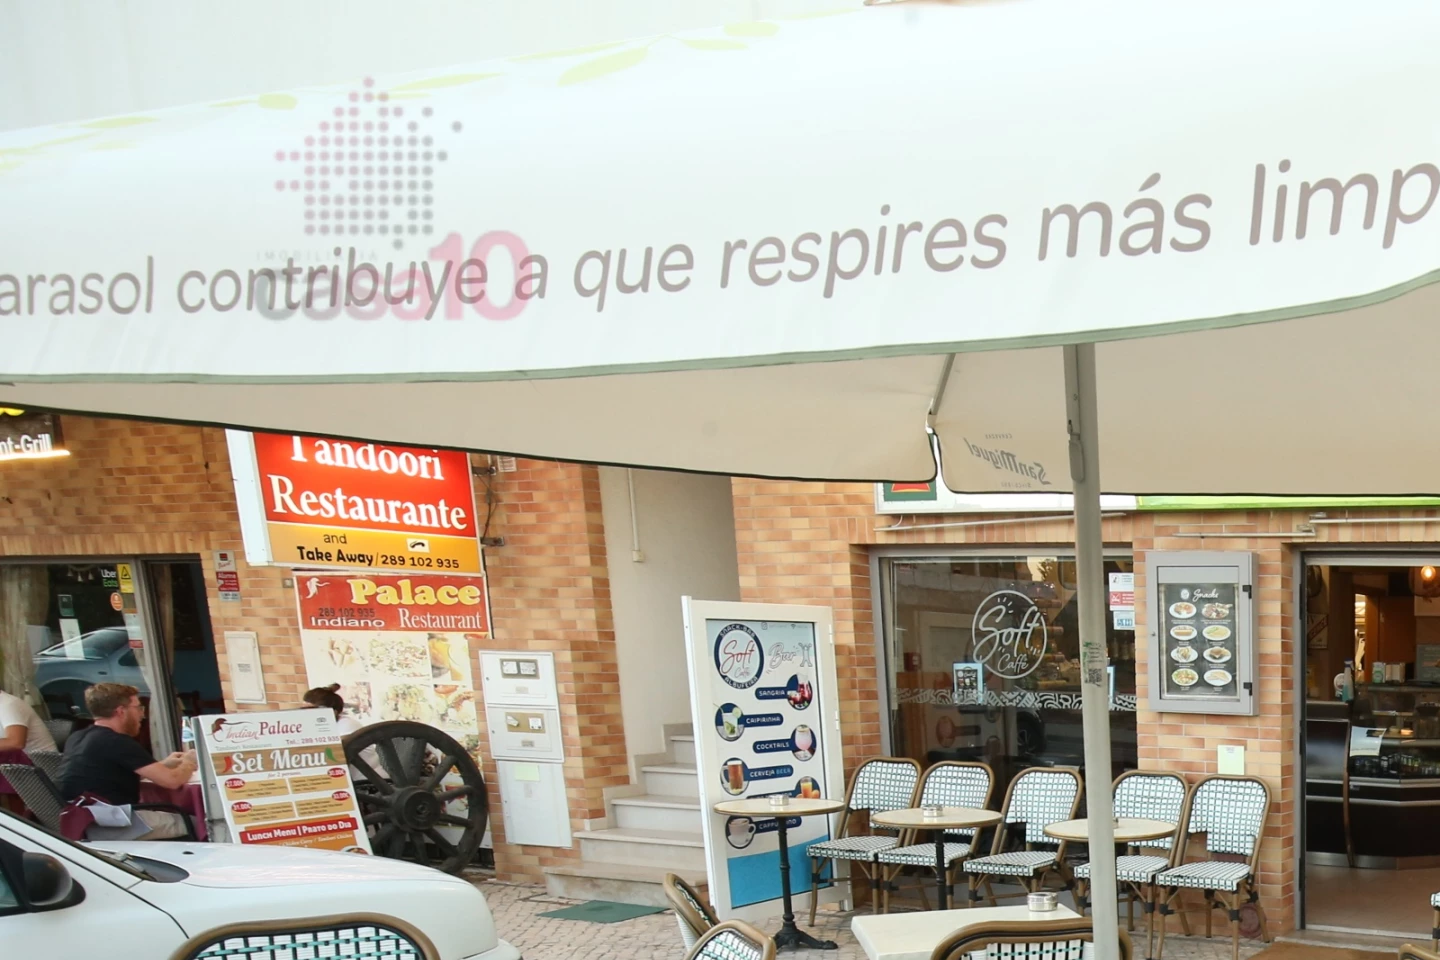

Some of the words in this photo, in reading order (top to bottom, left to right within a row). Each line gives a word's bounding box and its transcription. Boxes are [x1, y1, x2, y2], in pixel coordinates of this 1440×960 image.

[0, 255, 154, 316] arasol
[177, 246, 488, 321] contribuye
[514, 254, 548, 300] a
[574, 244, 694, 313] que
[719, 204, 1008, 299] respires
[1037, 173, 1212, 262] más
[267, 473, 468, 530] Restaurante
[323, 533, 348, 545] and
[297, 546, 333, 562] Take
[380, 555, 406, 566] 289
[410, 556, 433, 567] 102
[437, 558, 460, 569] 935
[101, 568, 117, 578] Uber
[347, 578, 481, 606] Palace
[318, 607, 336, 617] 289
[338, 608, 355, 618] 102
[357, 608, 376, 618] 935
[397, 608, 483, 630] Restaurant
[311, 616, 385, 628] Indiano
[973, 605, 1041, 663] Soft
[721, 639, 755, 674] Soft
[759, 689, 786, 697] SANGRIA
[259, 720, 303, 736] Palace
[756, 742, 790, 750] COCKTAILS
[231, 752, 264, 774] Set
[270, 750, 327, 770] Menu
[750, 770, 775, 778] CERVEJA
[759, 818, 797, 830] CAPPUINO
